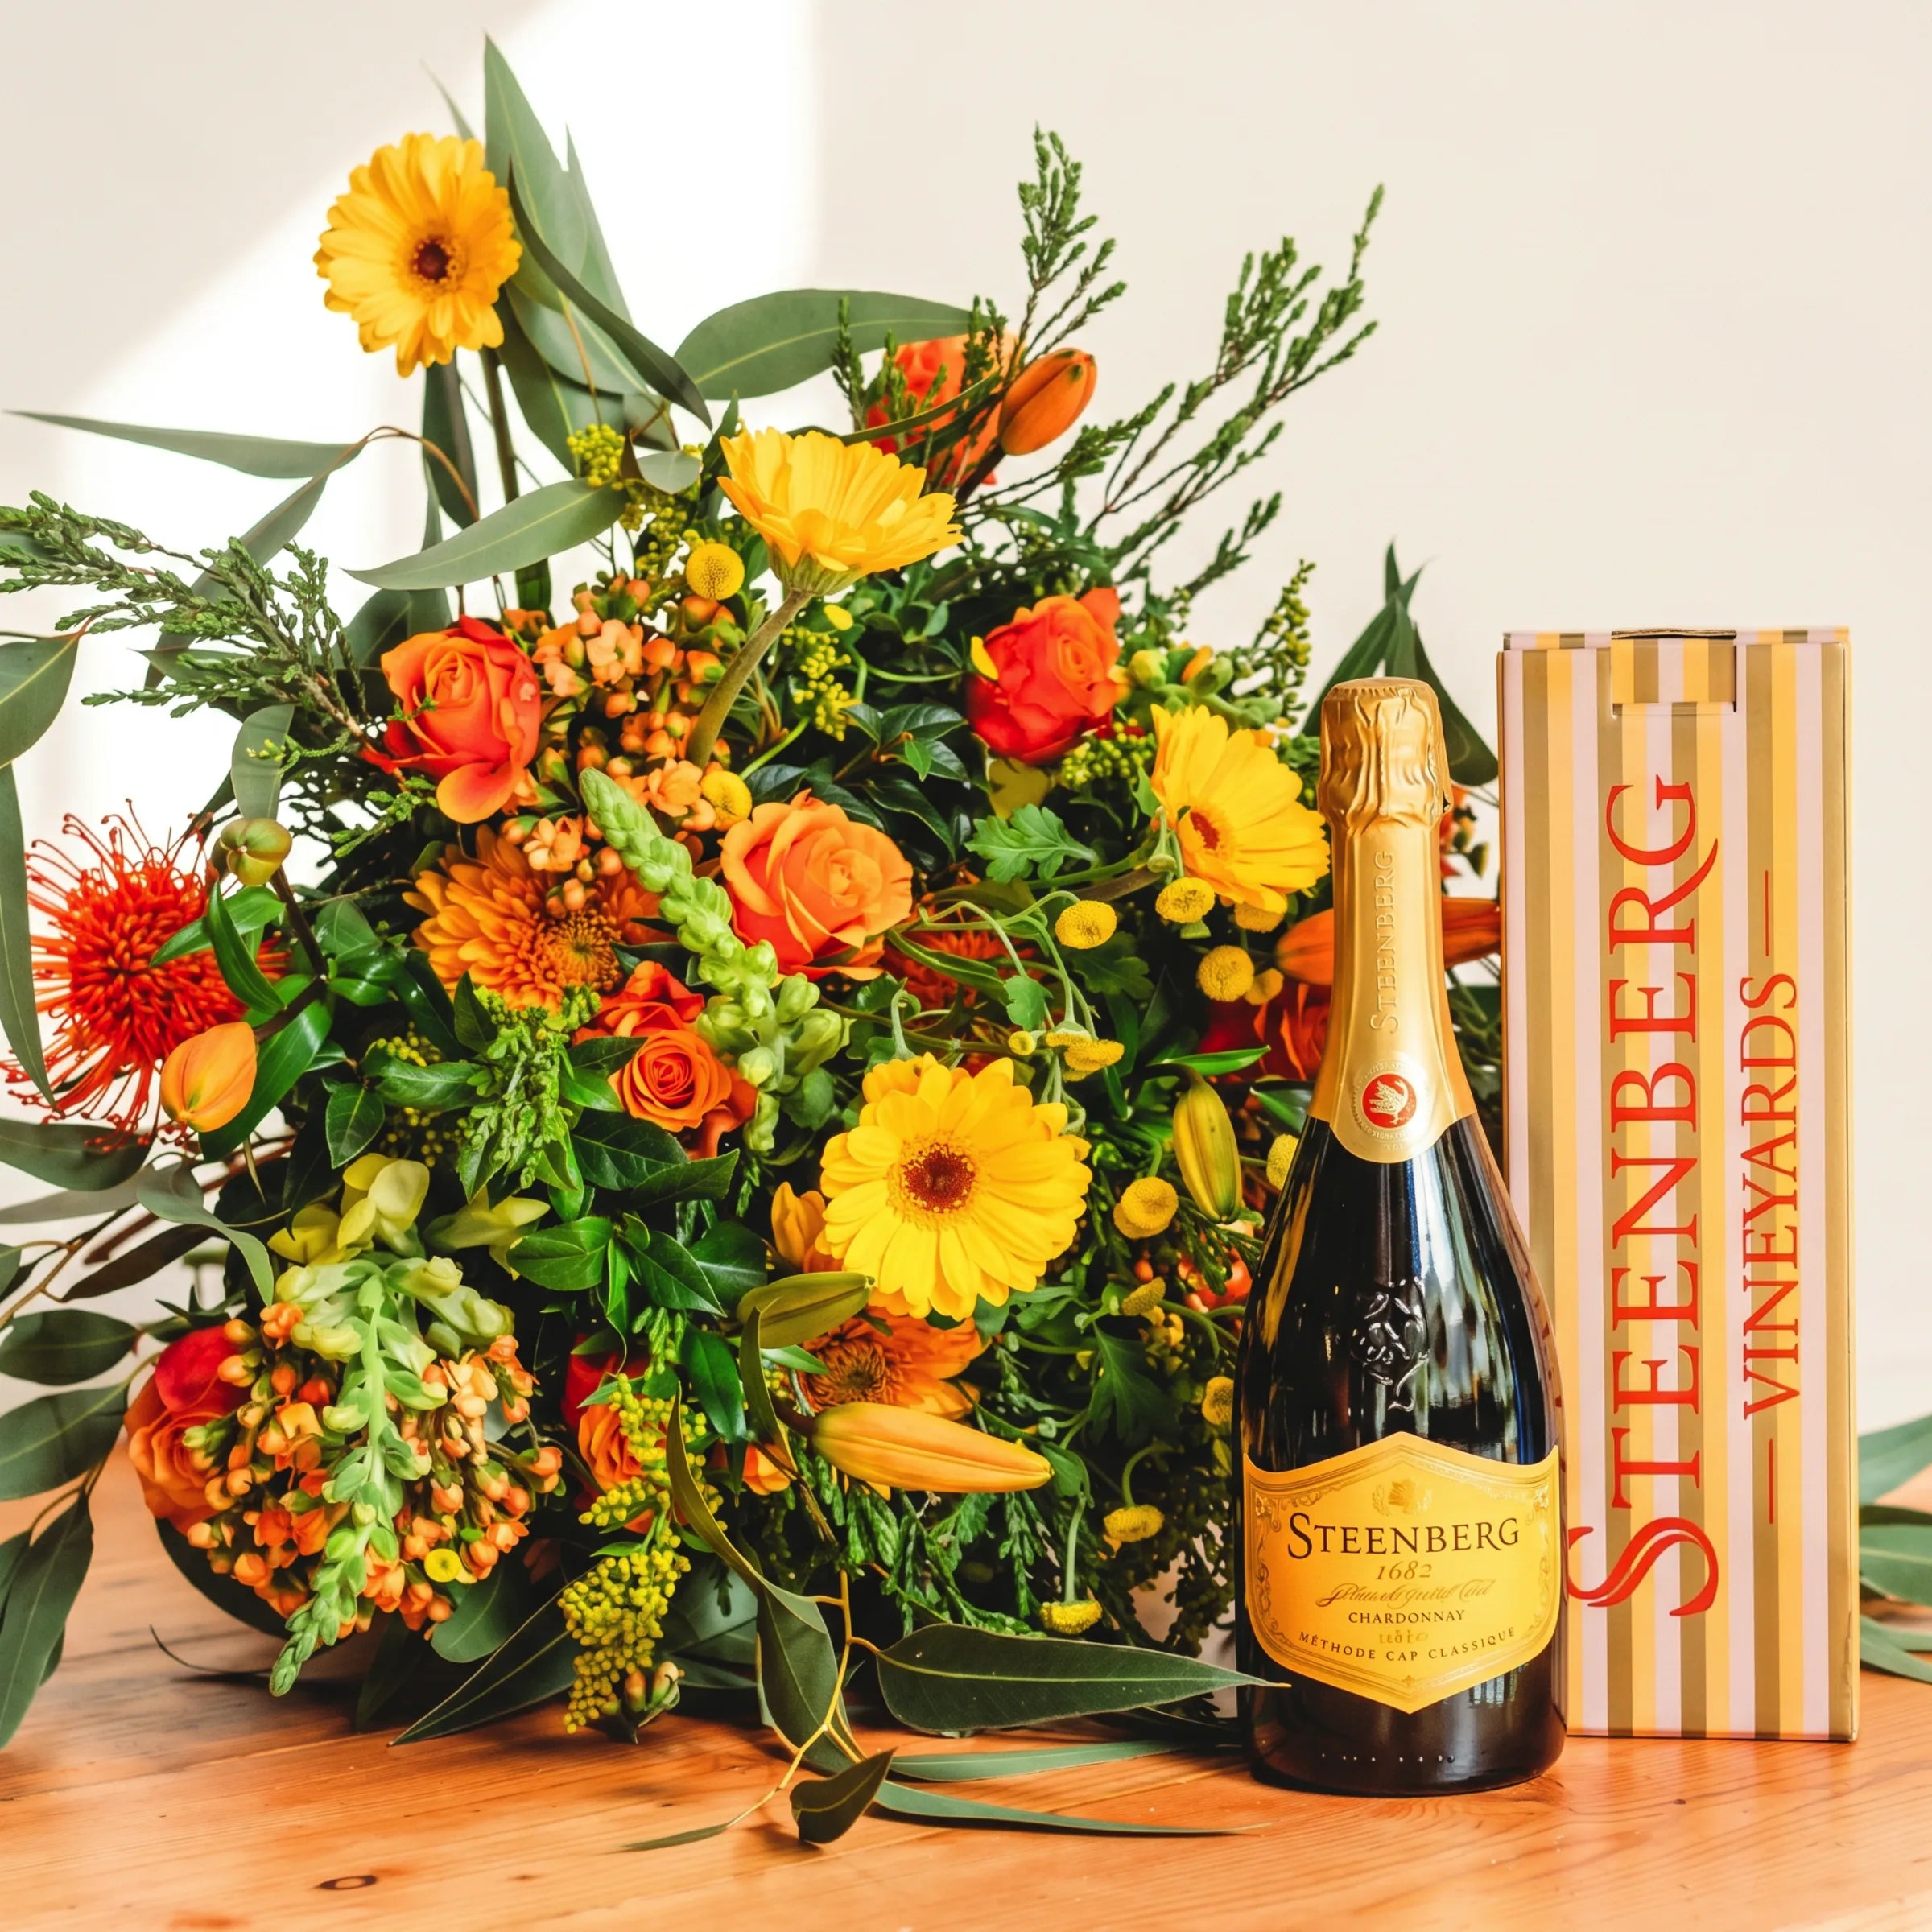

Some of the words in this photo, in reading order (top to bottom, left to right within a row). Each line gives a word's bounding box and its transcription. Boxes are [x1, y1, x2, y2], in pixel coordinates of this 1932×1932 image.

[1370, 850, 1399, 1034] STEENBERG
[1567, 774, 1719, 1616] STEENBERG
[1739, 973, 1800, 1420] VINEYARDS
[1287, 1512, 1520, 1559] STEENBERG
[1375, 1560, 1432, 1580] 1682
[1348, 1609, 1465, 1624] CHARDONNAY
[1298, 1631, 1376, 1660] MÉTHODE
[1386, 1651, 1418, 1662] CAP
[1428, 1626, 1515, 1660] CLASSIQUE
